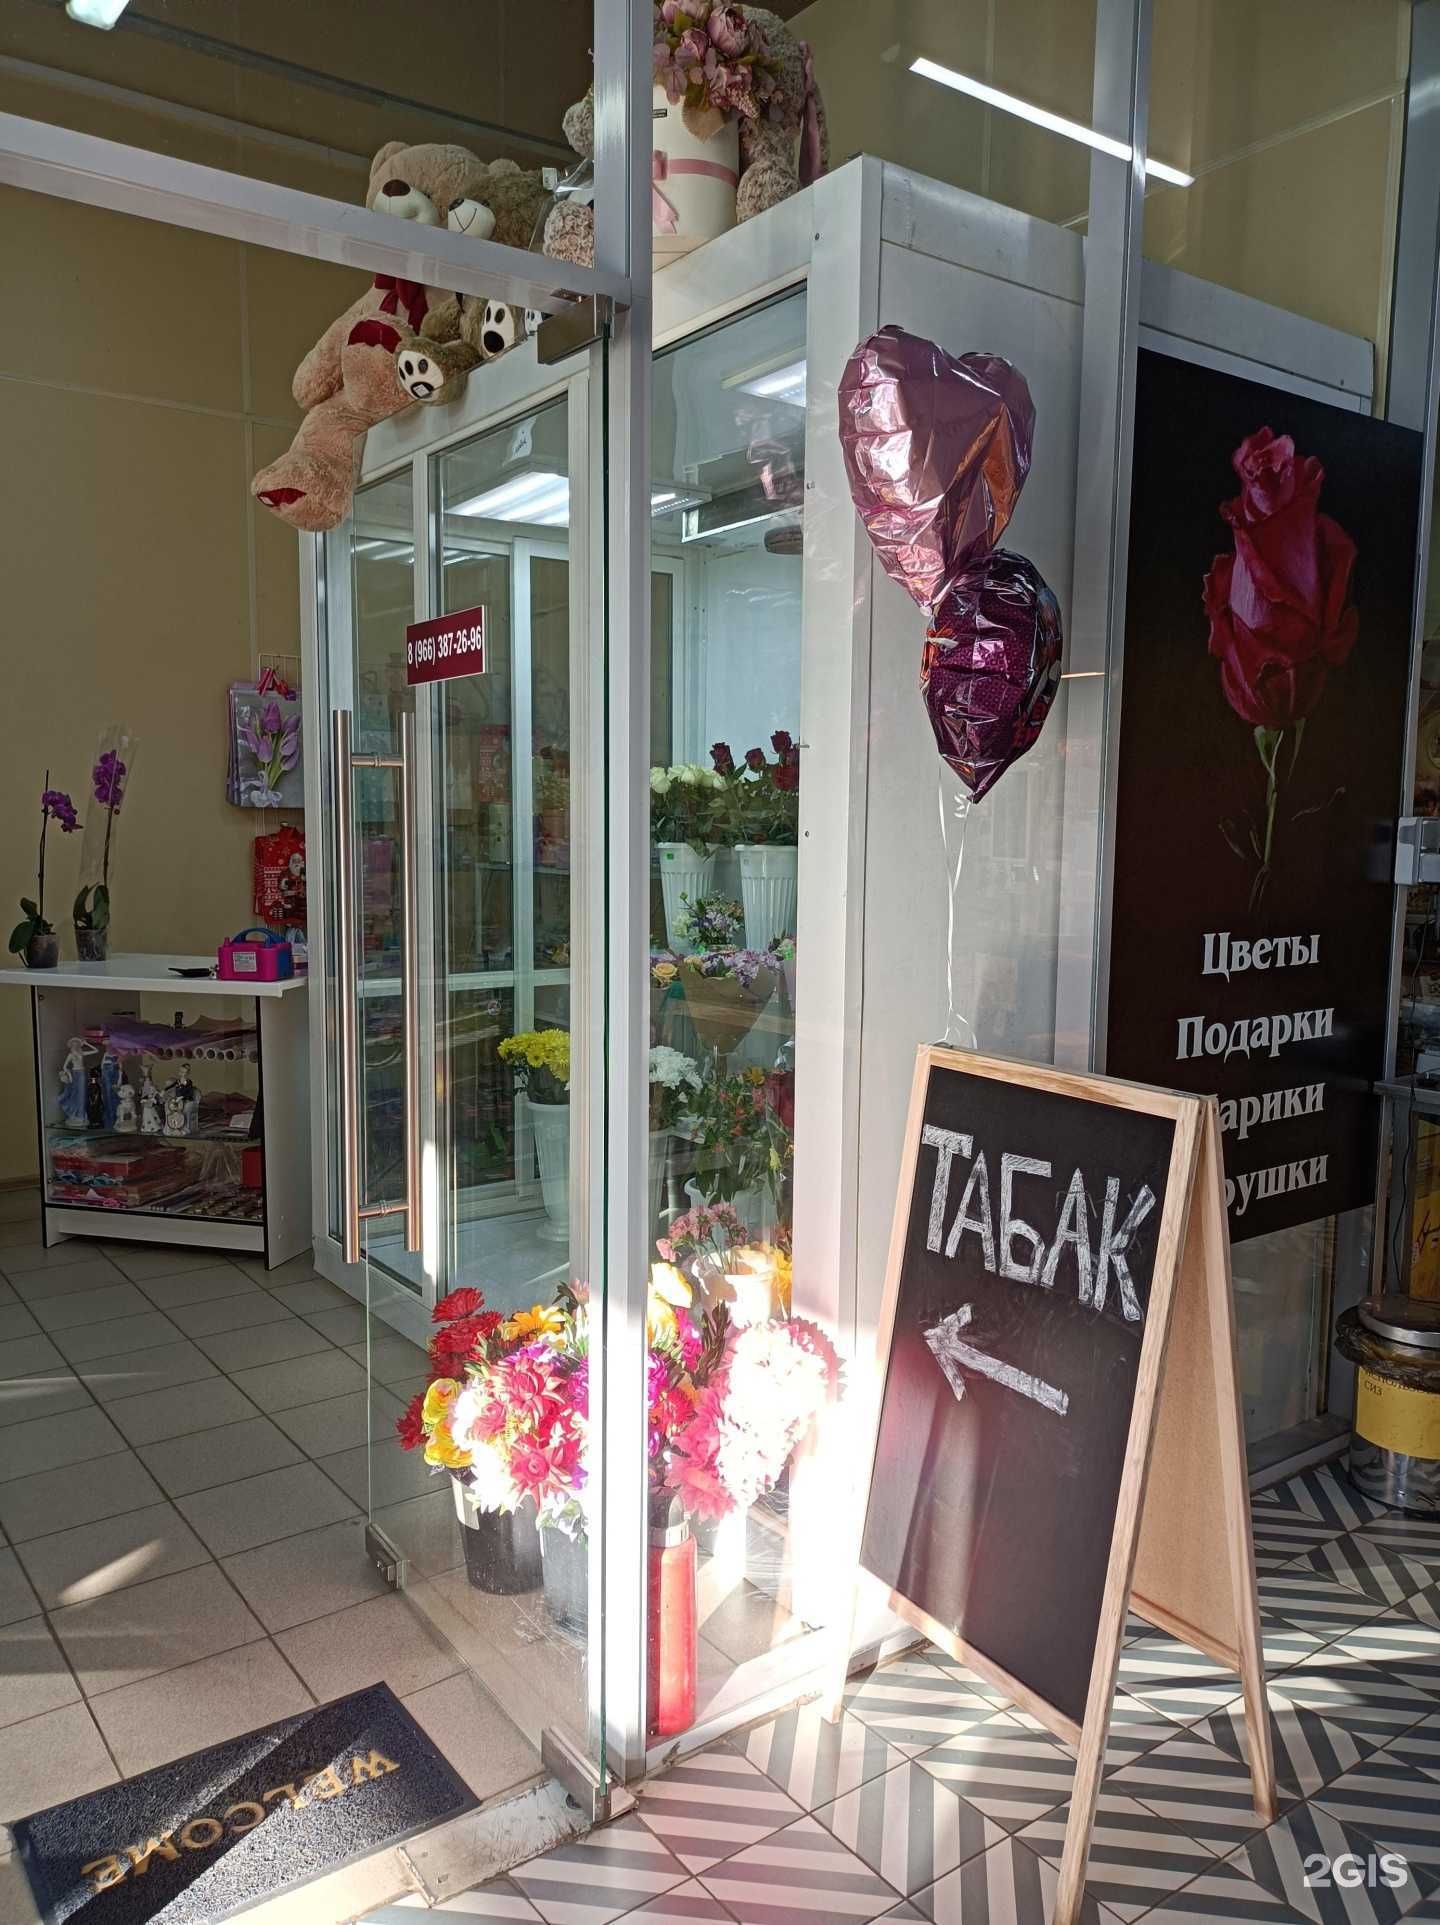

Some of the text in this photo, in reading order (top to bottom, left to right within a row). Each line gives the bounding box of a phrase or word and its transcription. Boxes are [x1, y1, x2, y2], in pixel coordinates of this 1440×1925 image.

[408, 625, 482, 669] 8 (966) 387-26-96
[1201, 931, 1321, 983] Цветы
[1175, 1007, 1335, 1063] Подарки
[1211, 1082, 1326, 1140] арики
[921, 1123, 1157, 1322] ТАБАК
[80, 1750, 400, 1893] WELCOME
